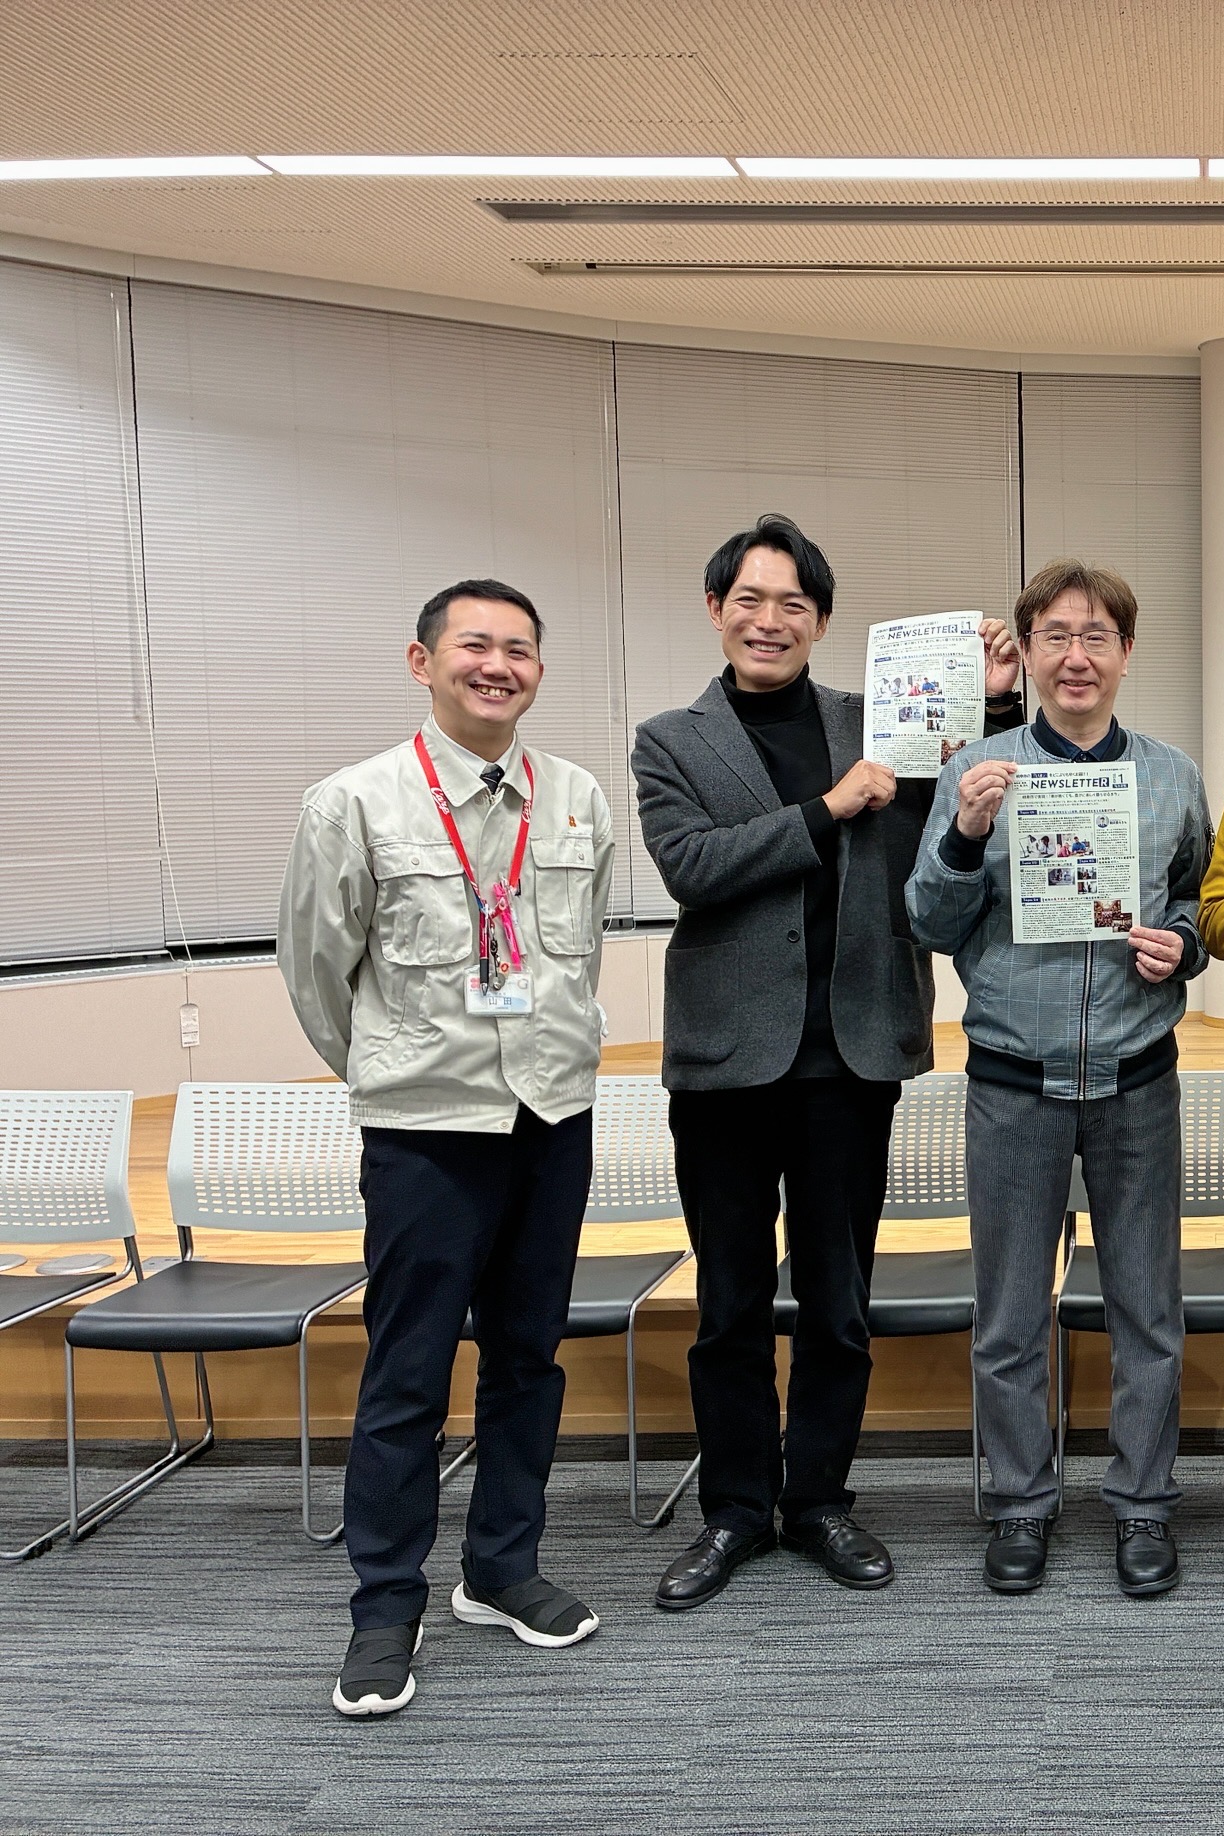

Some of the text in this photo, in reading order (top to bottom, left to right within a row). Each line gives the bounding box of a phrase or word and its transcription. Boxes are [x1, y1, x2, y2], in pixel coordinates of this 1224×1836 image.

[888, 625, 957, 640] NEWSLETTER
[1030, 777, 1108, 789] NEWSLETTER
[1118, 774, 1123, 783] 1
[431, 787, 450, 814] Carp
